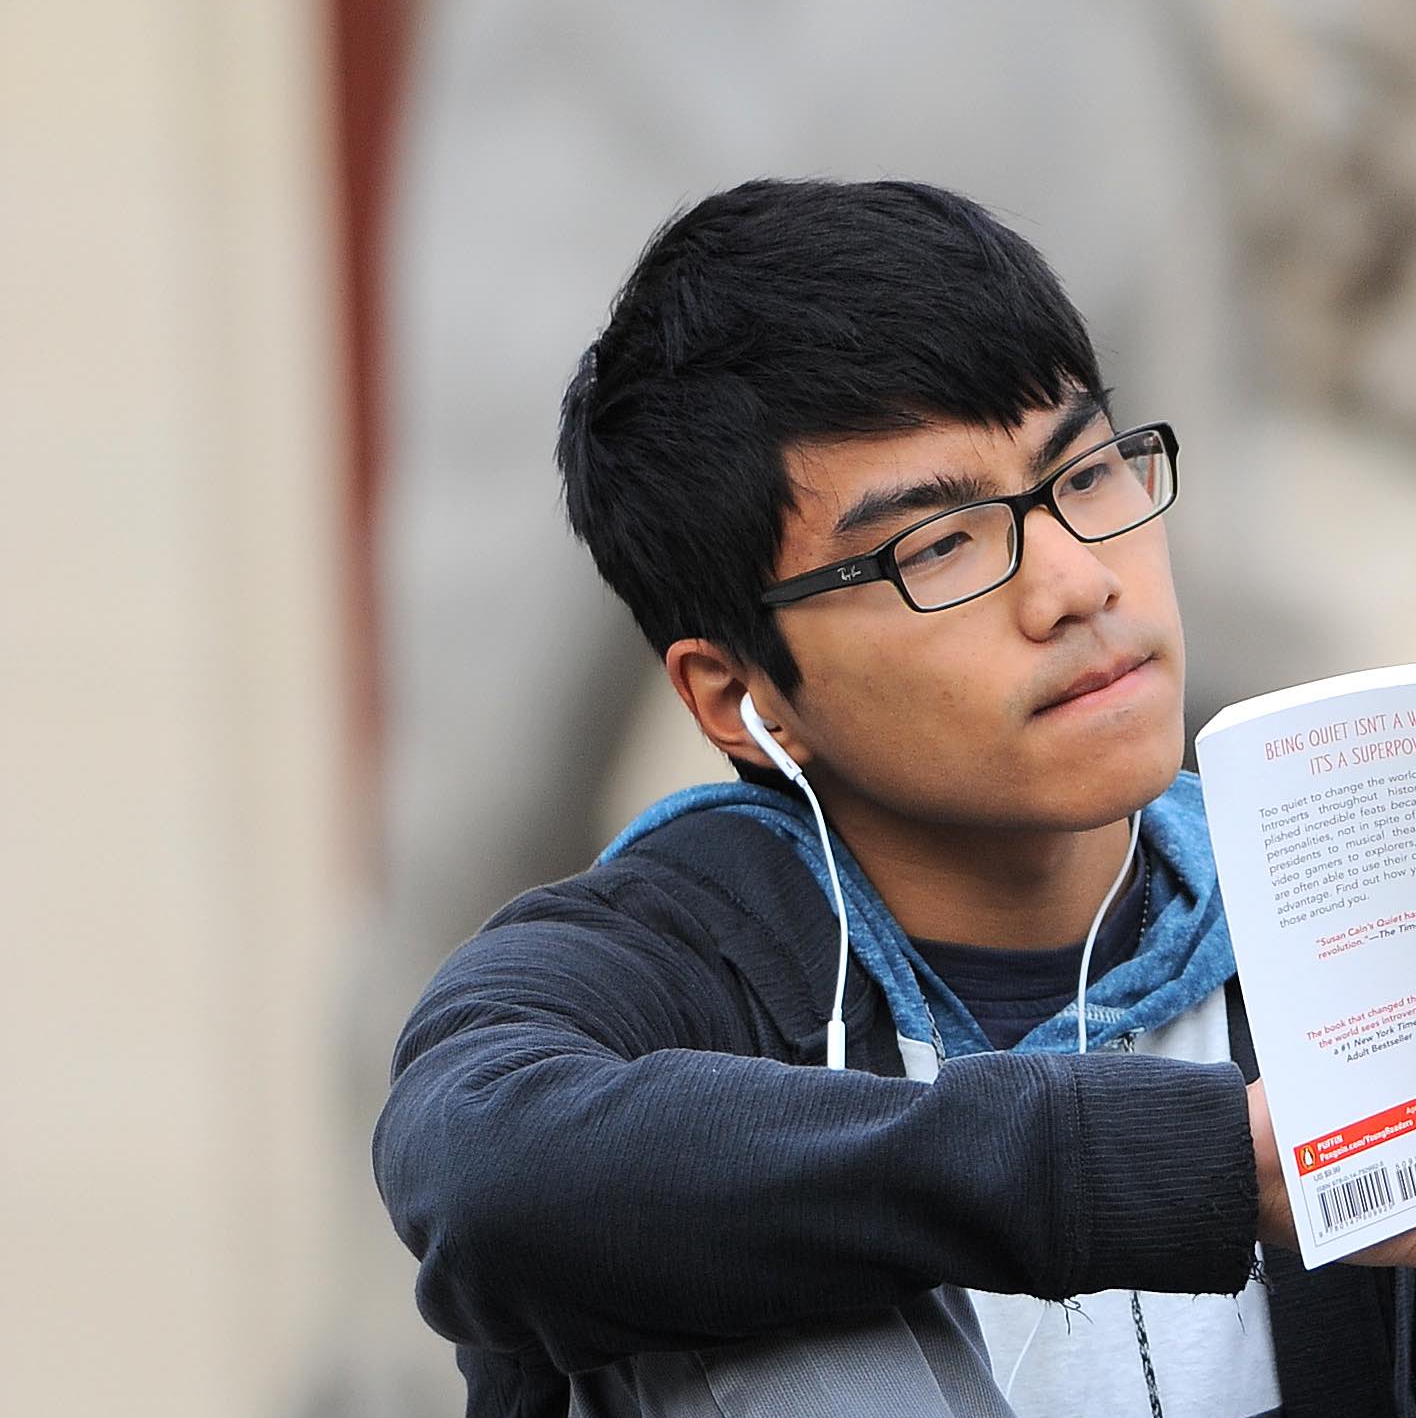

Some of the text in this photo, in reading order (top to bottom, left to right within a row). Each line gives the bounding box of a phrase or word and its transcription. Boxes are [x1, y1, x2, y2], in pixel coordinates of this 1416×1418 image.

[1265, 734, 1304, 761] BEING
[1309, 722, 1349, 747] QUIET
[1355, 713, 1387, 736] ISN'T
[1393, 712, 1404, 729] A
[1310, 754, 1334, 775] IT'S
[1338, 751, 1348, 768] A
[1259, 807, 1278, 819] Too
[1281, 797, 1308, 813] quiet
[1311, 793, 1322, 803] to
[1325, 781, 1364, 799] change
[1367, 776, 1385, 787] the
[1261, 811, 1309, 832] Introverts
[1318, 792, 1378, 814] throughout
[1264, 828, 1300, 849] plished
[1305, 810, 1356, 832] incredible
[1360, 804, 1386, 817] feats
[1266, 835, 1334, 863] personalities,
[1338, 826, 1355, 837] not
[1360, 822, 1369, 831] in
[1374, 815, 1400, 830] spite
[1405, 811, 1416, 821] of
[1269, 851, 1322, 876] presidents
[1328, 845, 1339, 854] to
[1346, 832, 1385, 849] musical
[1272, 872, 1300, 887] video
[1305, 858, 1343, 878] gamers
[1348, 853, 1359, 863] to
[1274, 891, 1290, 901] are
[1293, 880, 1319, 895] often
[1322, 871, 1345, 885] able
[1347, 867, 1359, 877] to
[1362, 862, 1380, 873] use
[1383, 854, 1408, 867] their
[1277, 890, 1333, 915] advantage.
[1336, 881, 1359, 894] Find
[1362, 875, 1380, 887] out
[1383, 869, 1407, 881] how
[1279, 893, 1370, 929] those around you.
[1348, 922, 1375, 937] Cain's
[1376, 914, 1402, 928] Quiet
[1306, 1030, 1322, 1041] The
[1324, 1020, 1347, 1034] book
[1347, 1013, 1366, 1025] that
[1367, 998, 1405, 1017] changed
[1319, 1037, 1333, 1048] the
[1335, 1027, 1359, 1043] world
[1361, 1021, 1380, 1032] sees
[1341, 1042, 1351, 1052] #1
[1354, 1035, 1373, 1047] New
[1375, 1025, 1396, 1041] York
[1346, 1033, 1413, 1063] Adult Bestseller
[1317, 1134, 1344, 1151] PUFFIN
[1313, 1172, 1324, 1182] US
